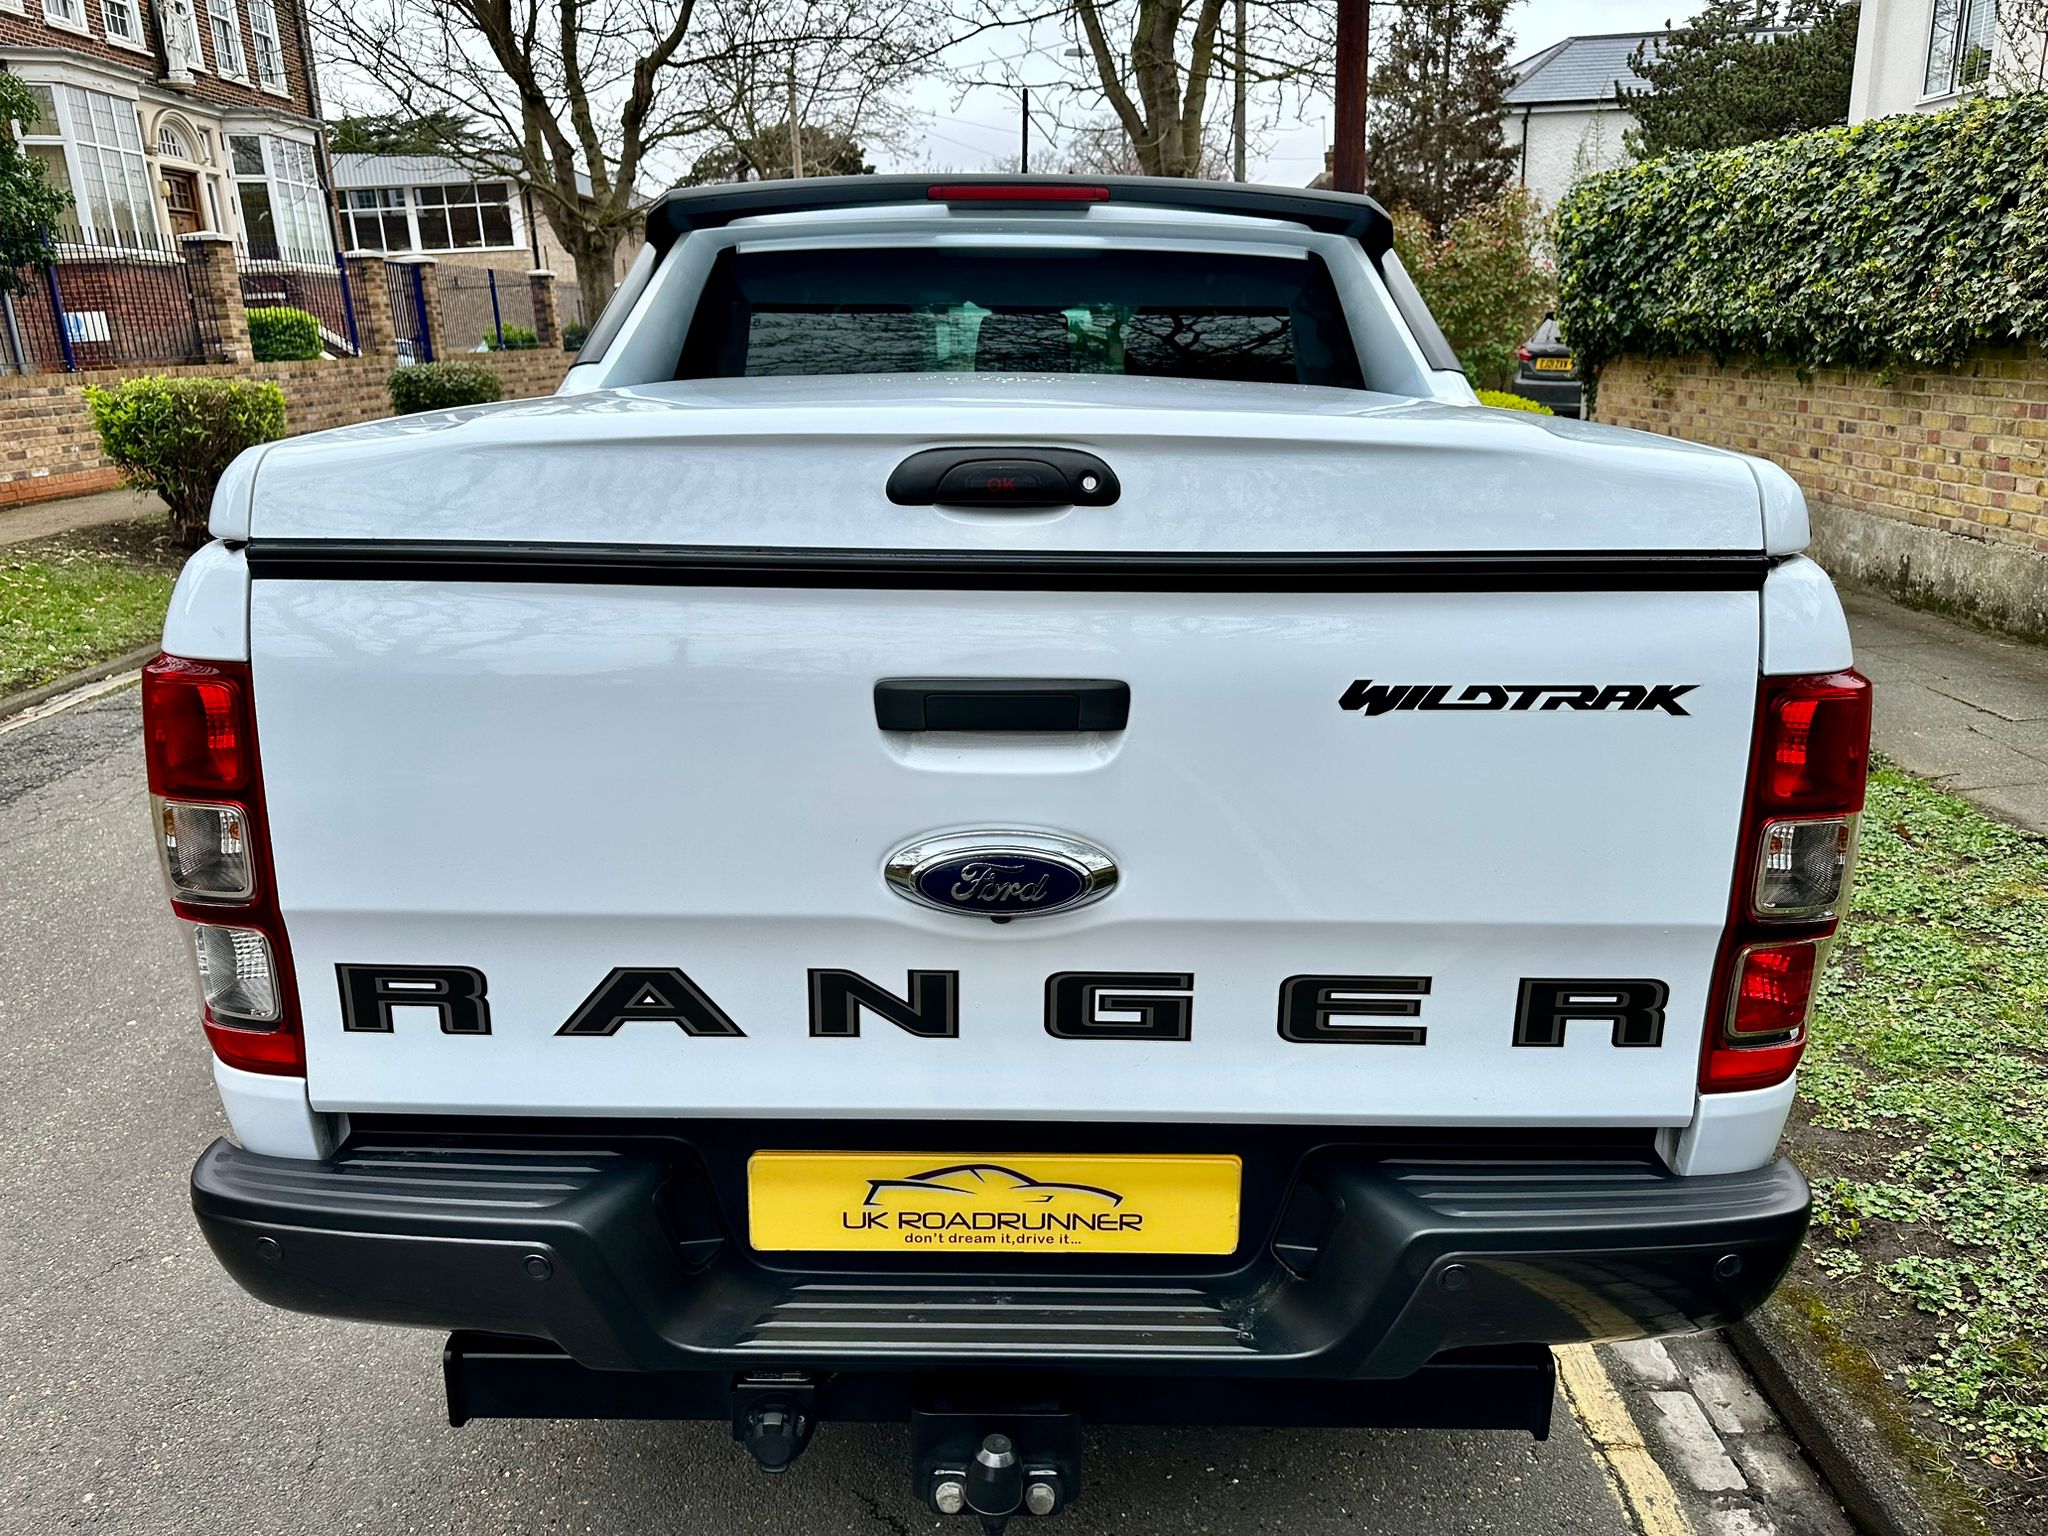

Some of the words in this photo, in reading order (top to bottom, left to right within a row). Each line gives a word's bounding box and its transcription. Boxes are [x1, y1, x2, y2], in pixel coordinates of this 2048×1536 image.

[1338, 679, 1701, 716] WILDTRAK
[951, 862, 1049, 901] Ford
[335, 962, 1670, 1049] RANGER
[842, 1211, 889, 1229] UK
[898, 1211, 1143, 1231] ROADRUNNER
[904, 1233, 945, 1243] don't
[948, 1233, 996, 1244] dream
